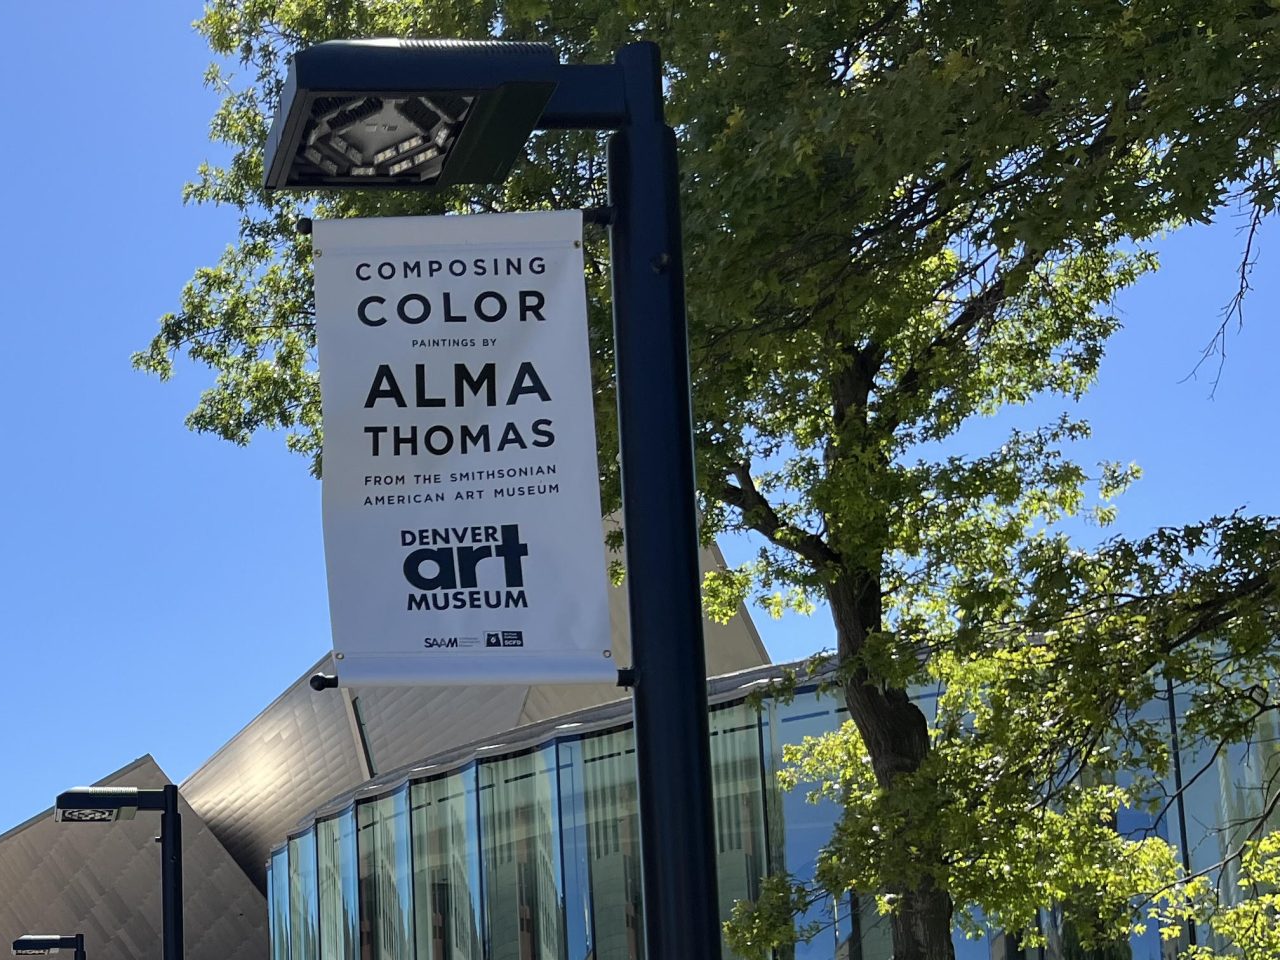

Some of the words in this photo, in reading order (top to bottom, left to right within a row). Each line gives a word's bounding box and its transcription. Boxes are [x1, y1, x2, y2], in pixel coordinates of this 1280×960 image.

[355, 256, 547, 281] COMPOSING
[357, 290, 546, 327] COLOR
[412, 338, 476, 348] PAINTINGS
[482, 338, 497, 348] BY
[363, 361, 551, 408] ALMA
[363, 418, 556, 457] THOMAS
[364, 474, 406, 487] FROM
[413, 472, 442, 485] THE
[449, 464, 557, 483] SMITHSONIAN
[363, 491, 445, 507] AMERICAN
[455, 489, 485, 502] ART
[494, 483, 560, 498] MUSEUM
[401, 525, 499, 547] DENVER
[403, 524, 528, 591] art
[407, 589, 528, 611] MUSEUM
[424, 637, 458, 648] SAAM
